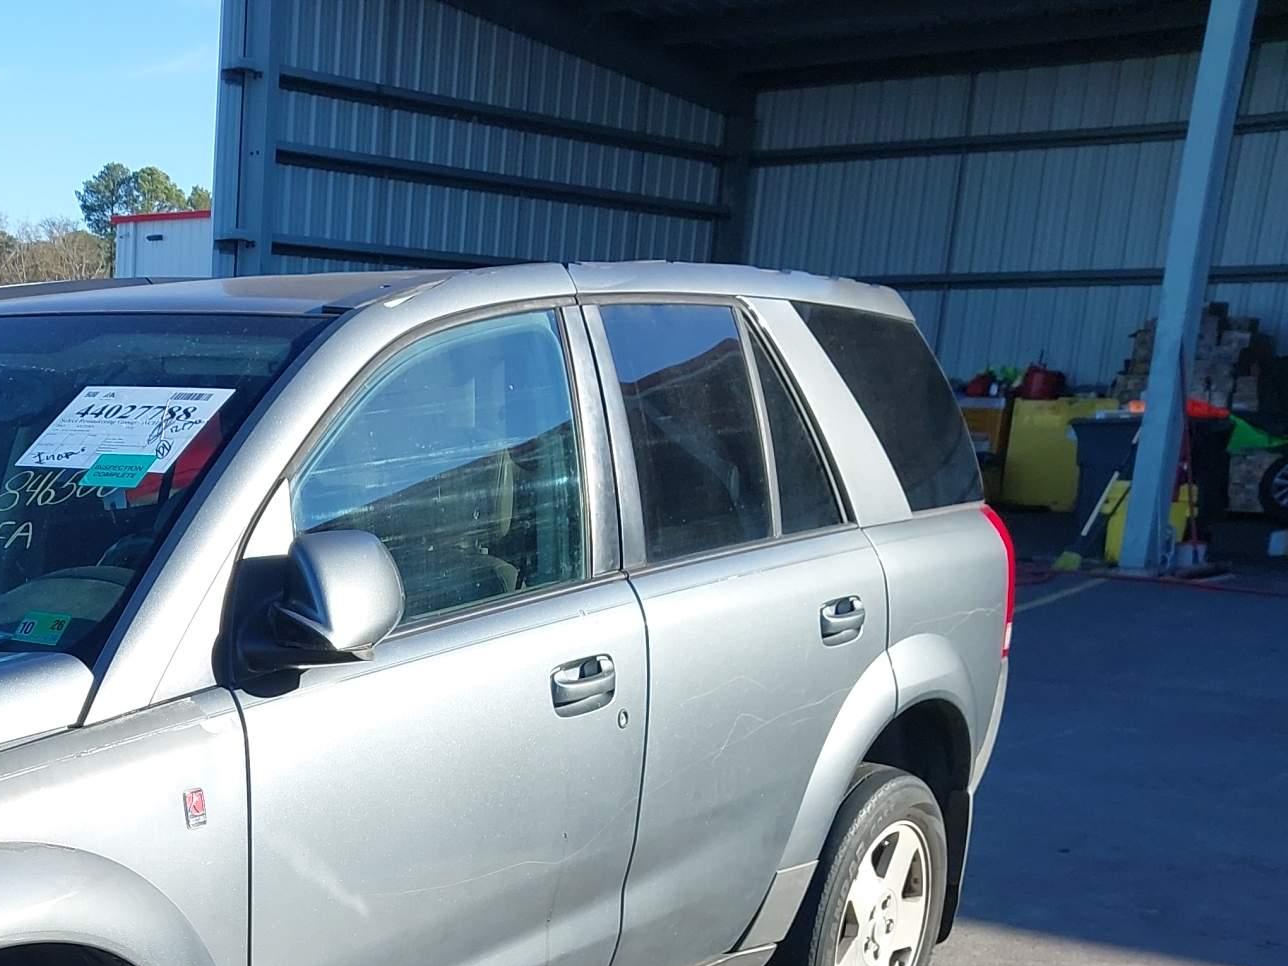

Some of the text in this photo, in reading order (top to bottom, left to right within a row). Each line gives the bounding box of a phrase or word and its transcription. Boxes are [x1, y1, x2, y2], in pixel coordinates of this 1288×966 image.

[75, 403, 198, 422] 44027788
[94, 464, 144, 472] INSPECTION
[93, 471, 137, 479] COMPLETE
[19, 619, 66, 635] 10 26
